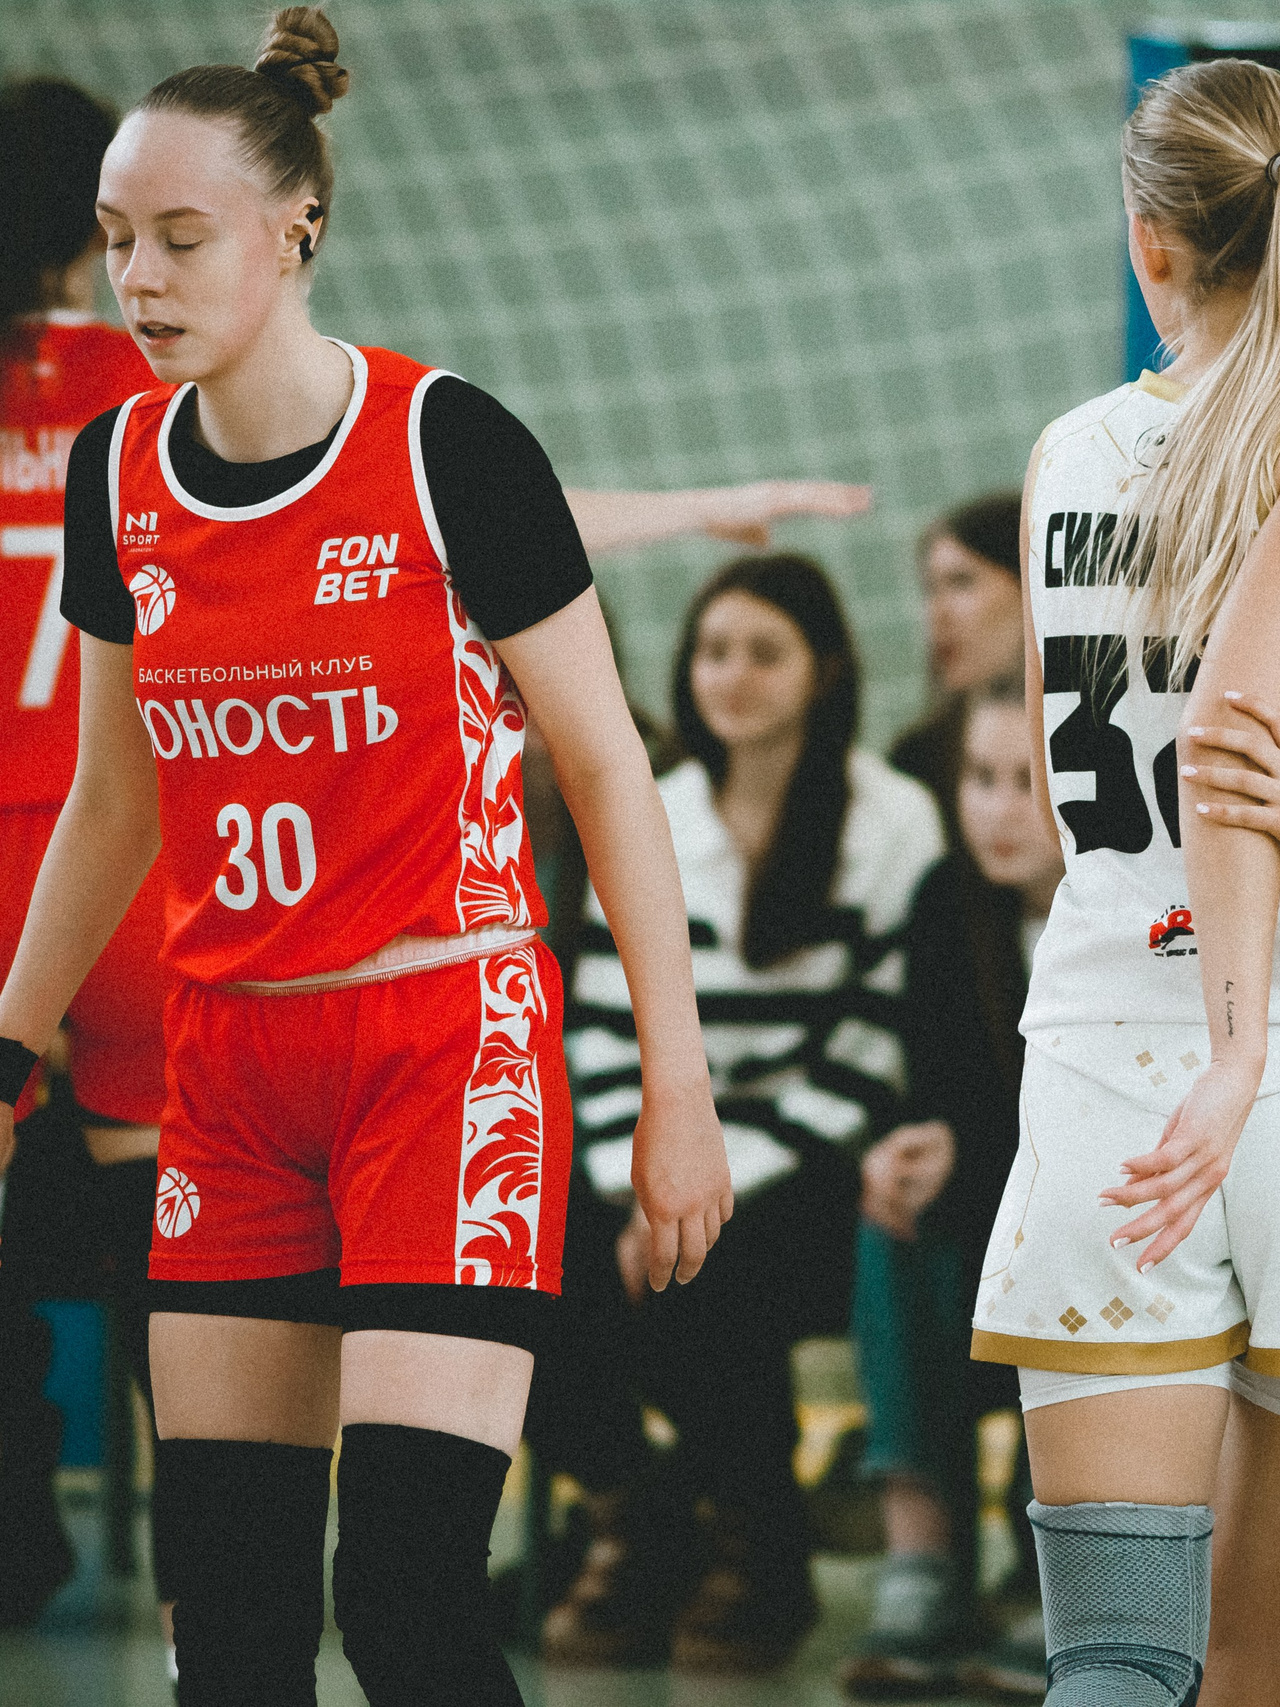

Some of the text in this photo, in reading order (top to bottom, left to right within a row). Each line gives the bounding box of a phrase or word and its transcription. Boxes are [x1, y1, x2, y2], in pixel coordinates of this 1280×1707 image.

[122, 534, 160, 546] SPORT
[125, 511, 158, 532] N1
[316, 532, 400, 570] FON
[313, 567, 399, 605] BET
[0, 525, 73, 709] 7
[138, 654, 373, 684] БАСКЕТБОЛЬНЫЙ КЛУБ
[214, 801, 317, 911] 30
